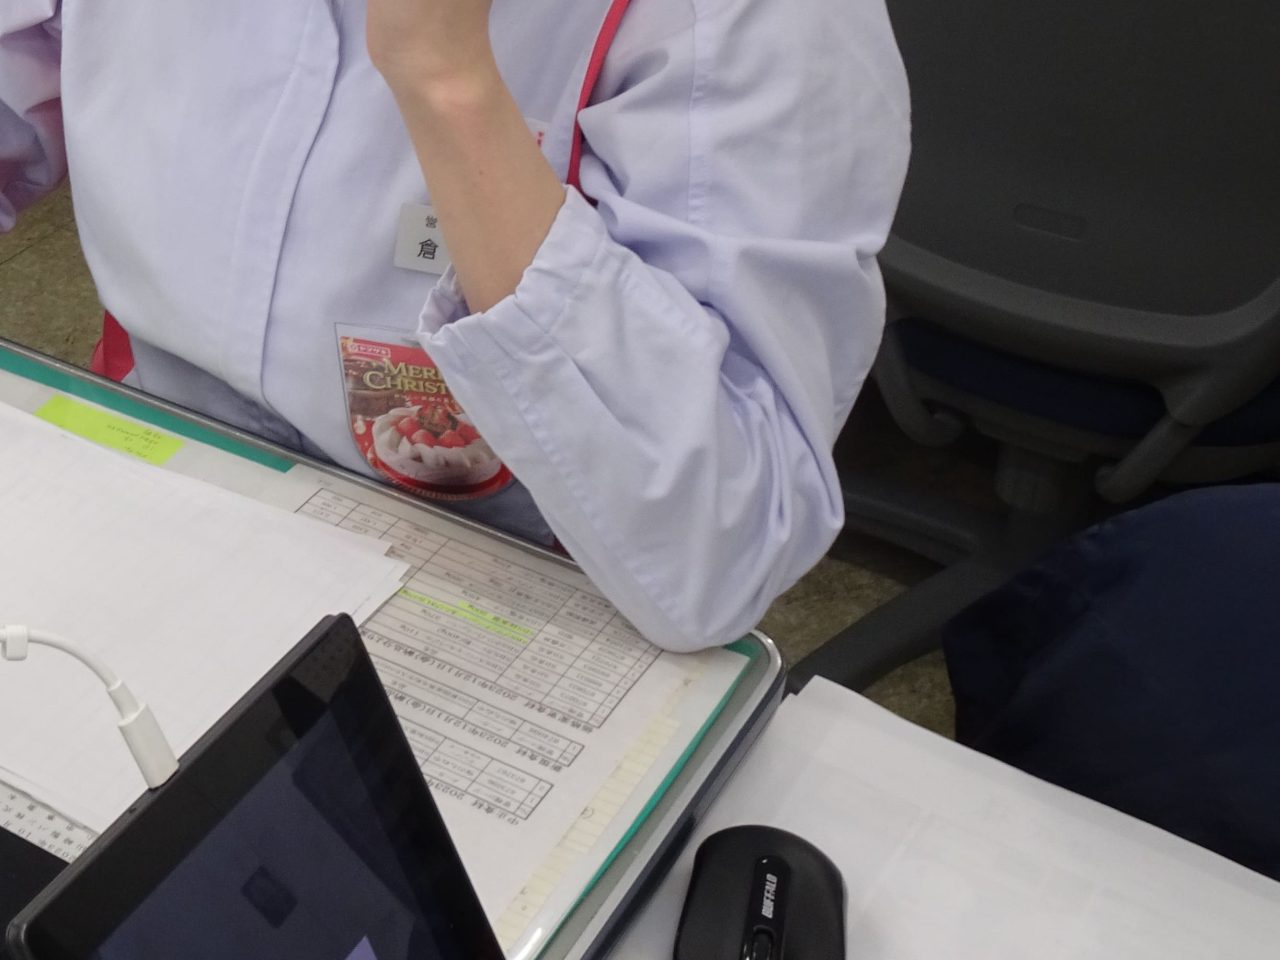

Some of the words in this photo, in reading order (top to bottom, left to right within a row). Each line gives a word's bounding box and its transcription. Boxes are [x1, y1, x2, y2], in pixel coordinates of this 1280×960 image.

[416, 238, 439, 261] 倉
[382, 357, 444, 381] MER
[362, 370, 448, 395] CHRIST
[762, 874, 777, 918] BUFFALO
